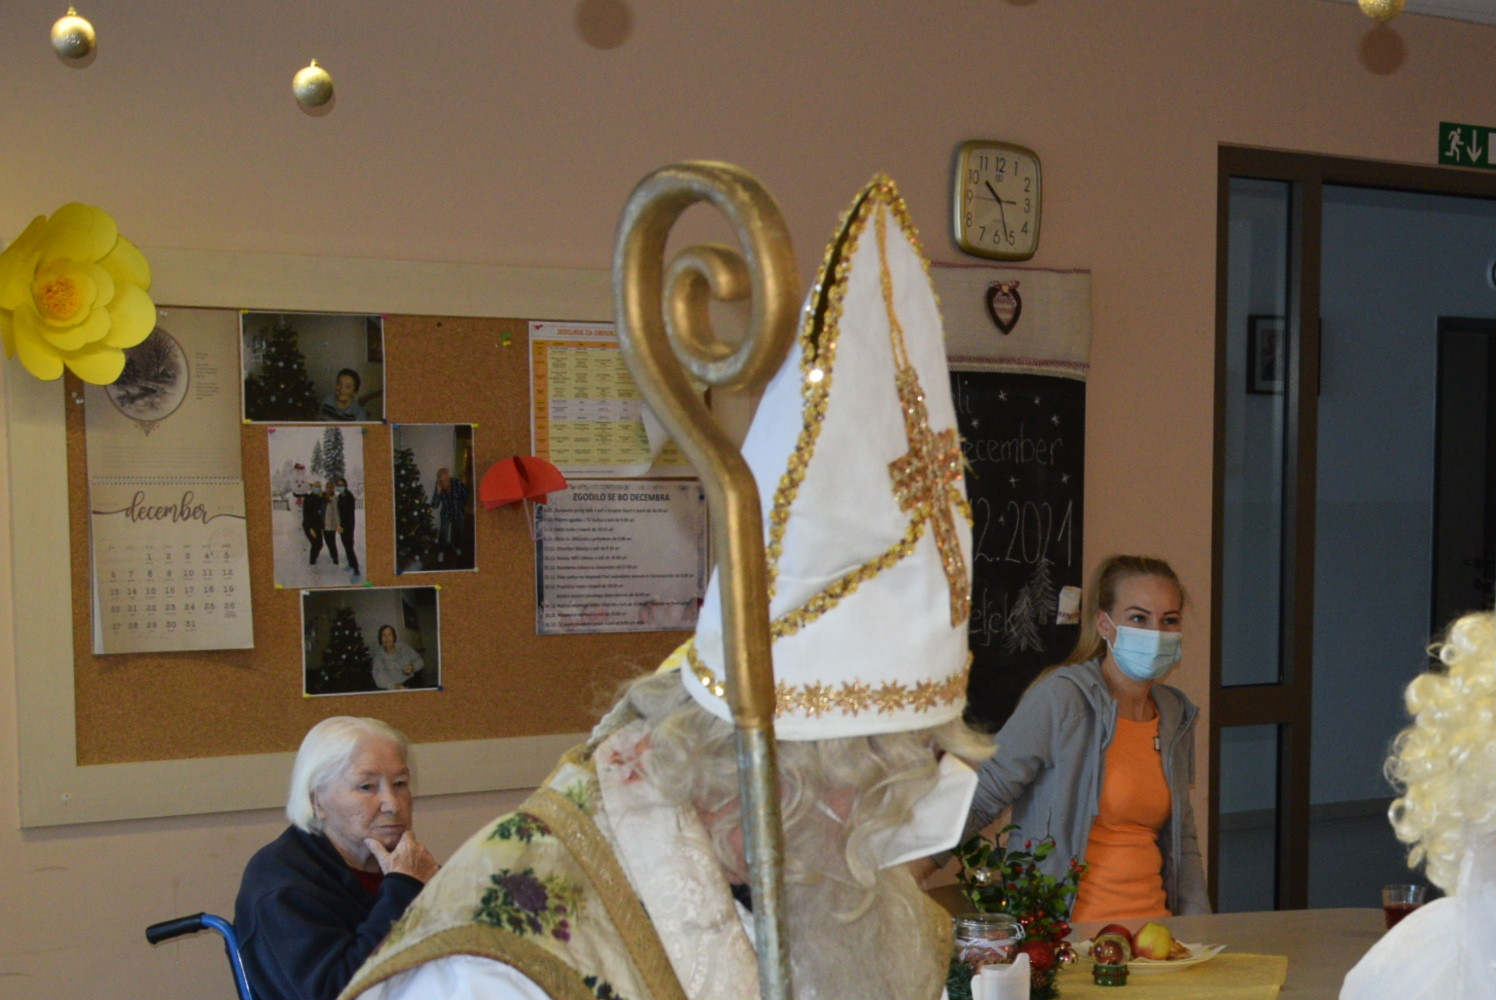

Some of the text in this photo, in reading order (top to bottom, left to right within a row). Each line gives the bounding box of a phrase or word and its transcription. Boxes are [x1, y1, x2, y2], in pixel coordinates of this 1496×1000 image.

[980, 156, 988, 171] 11
[995, 157, 1006, 173] 12
[1014, 162, 1018, 176] 1
[968, 168, 980, 185] 10
[1024, 177, 1030, 192] 2
[967, 190, 973, 204] 9
[1024, 198, 1030, 213] 3
[966, 212, 972, 227] 8
[979, 226, 986, 241] 7
[1021, 221, 1028, 234] 4
[994, 229, 1000, 244] 6
[1009, 231, 1015, 246] 5
[962, 422, 1063, 465] ecember
[573, 492, 670, 501] ZGODILO SE BO DECEMBRA
[125, 490, 209, 524] december
[970, 497, 1072, 567] 2.2021
[183, 569, 194, 577] 10
[185, 586, 194, 594] 17
[969, 588, 1017, 647] eljek
